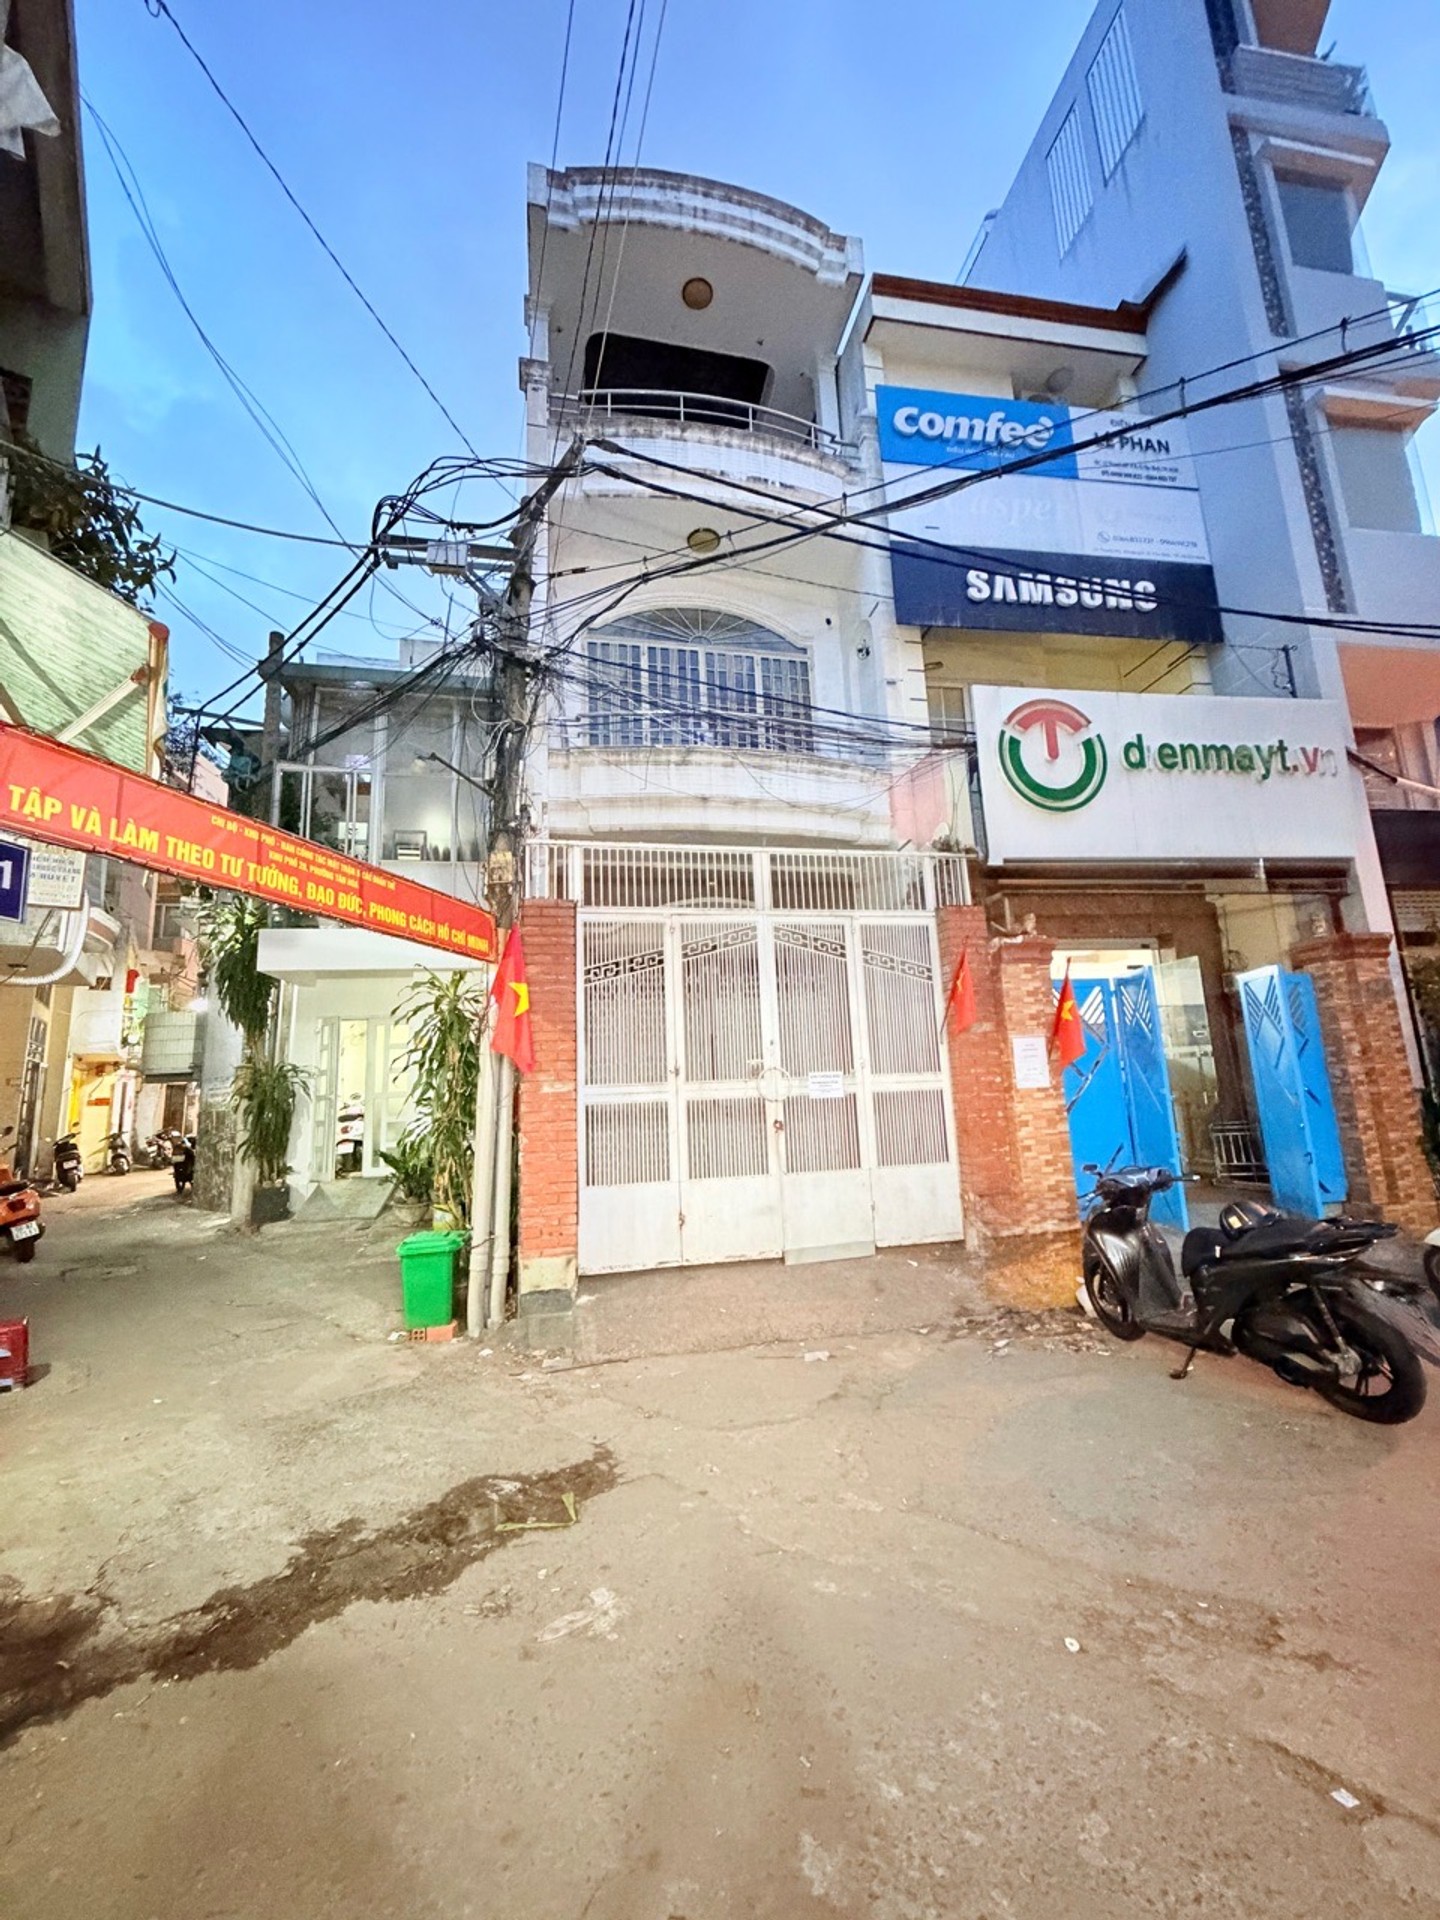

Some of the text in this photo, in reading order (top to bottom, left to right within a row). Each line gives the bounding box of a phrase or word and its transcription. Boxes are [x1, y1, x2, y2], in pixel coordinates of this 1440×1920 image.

[1119, 434, 1170, 455] PHAN
[966, 569, 1158, 612] SAMSUNG
[8, 784, 62, 822] TẬP
[70, 804, 102, 837] VÀ
[109, 817, 159, 854] LÀM
[165, 835, 215, 870] THEO
[220, 853, 245, 878] TƯ
[369, 901, 407, 928] PHONG
[408, 914, 436, 937] CÁCH
